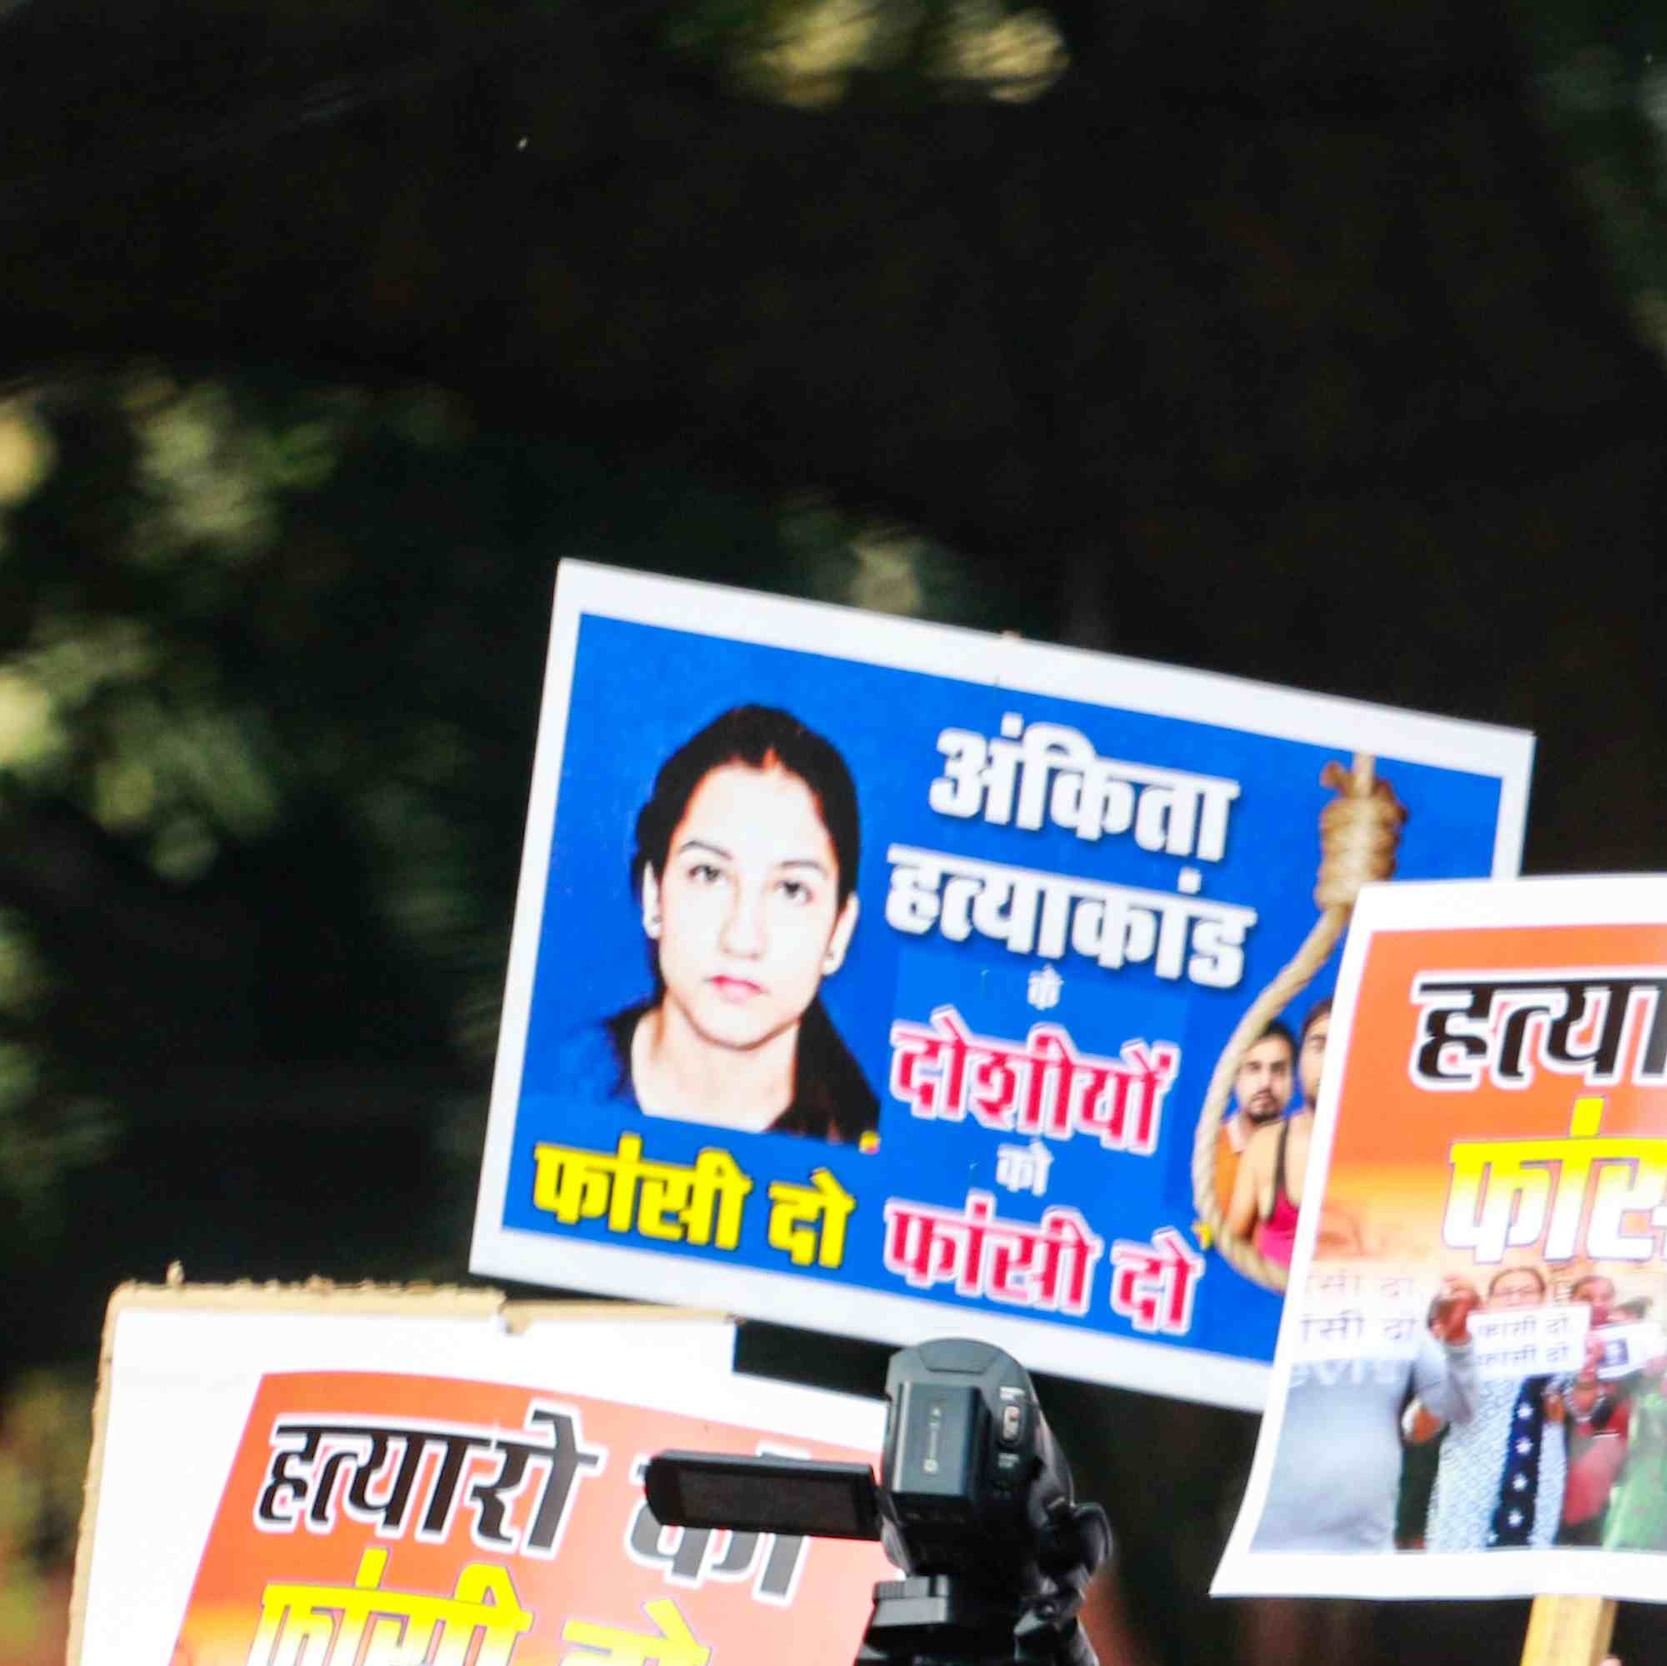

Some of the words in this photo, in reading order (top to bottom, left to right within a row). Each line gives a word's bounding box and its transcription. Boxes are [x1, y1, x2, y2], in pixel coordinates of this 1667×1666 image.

[928, 711, 1242, 862] अंकिता
[884, 843, 1259, 989] हत्याकांड
[890, 1004, 1181, 1157] दोशीयों
[532, 1131, 753, 1250] फांसी
[767, 1168, 856, 1269] दो
[997, 1139, 1054, 1196] को
[883, 1189, 1103, 1316] फांसी
[1111, 1227, 1204, 1335] दो
[253, 1399, 601, 1559] हत्यारो
